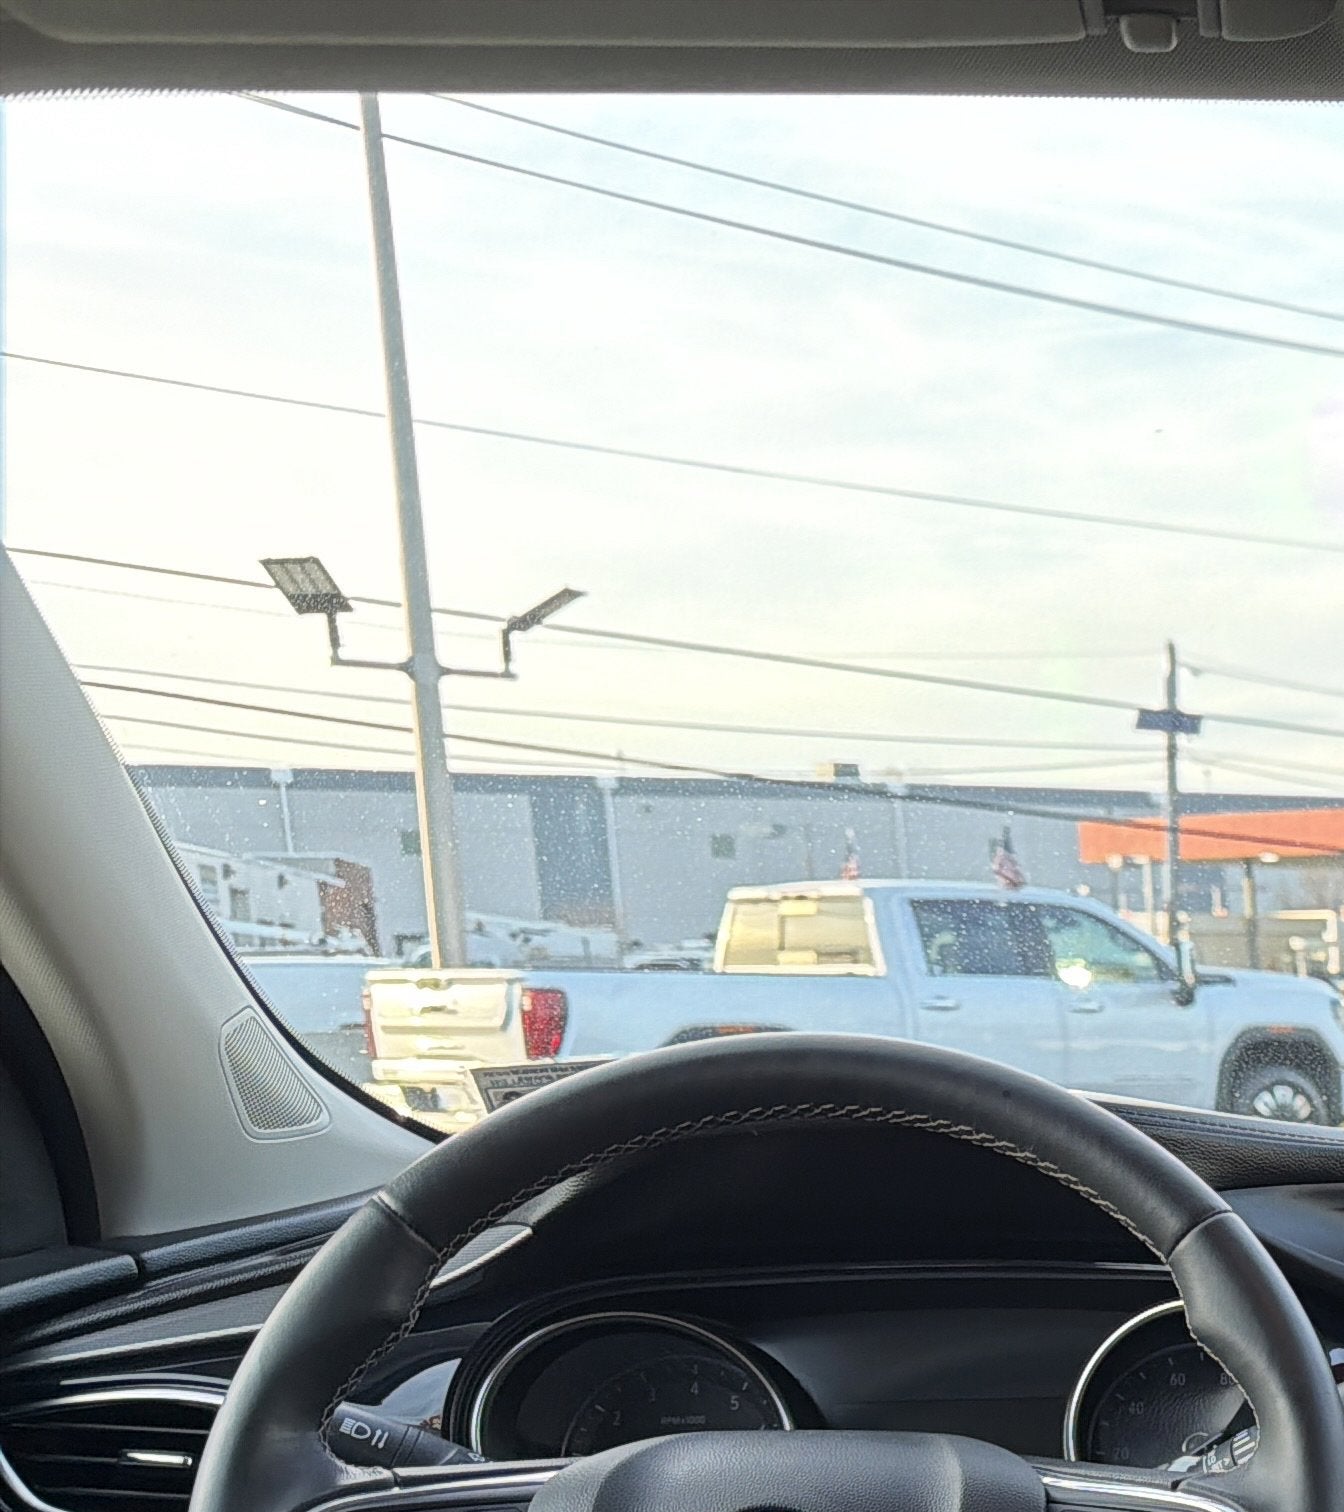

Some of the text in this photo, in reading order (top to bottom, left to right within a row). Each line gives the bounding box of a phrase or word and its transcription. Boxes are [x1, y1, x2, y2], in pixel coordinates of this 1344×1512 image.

[1169, 1372, 1186, 1386] 60
[1219, 1372, 1238, 1386] 80
[730, 1395, 740, 1412] 5
[1128, 1401, 1144, 1415] 40
